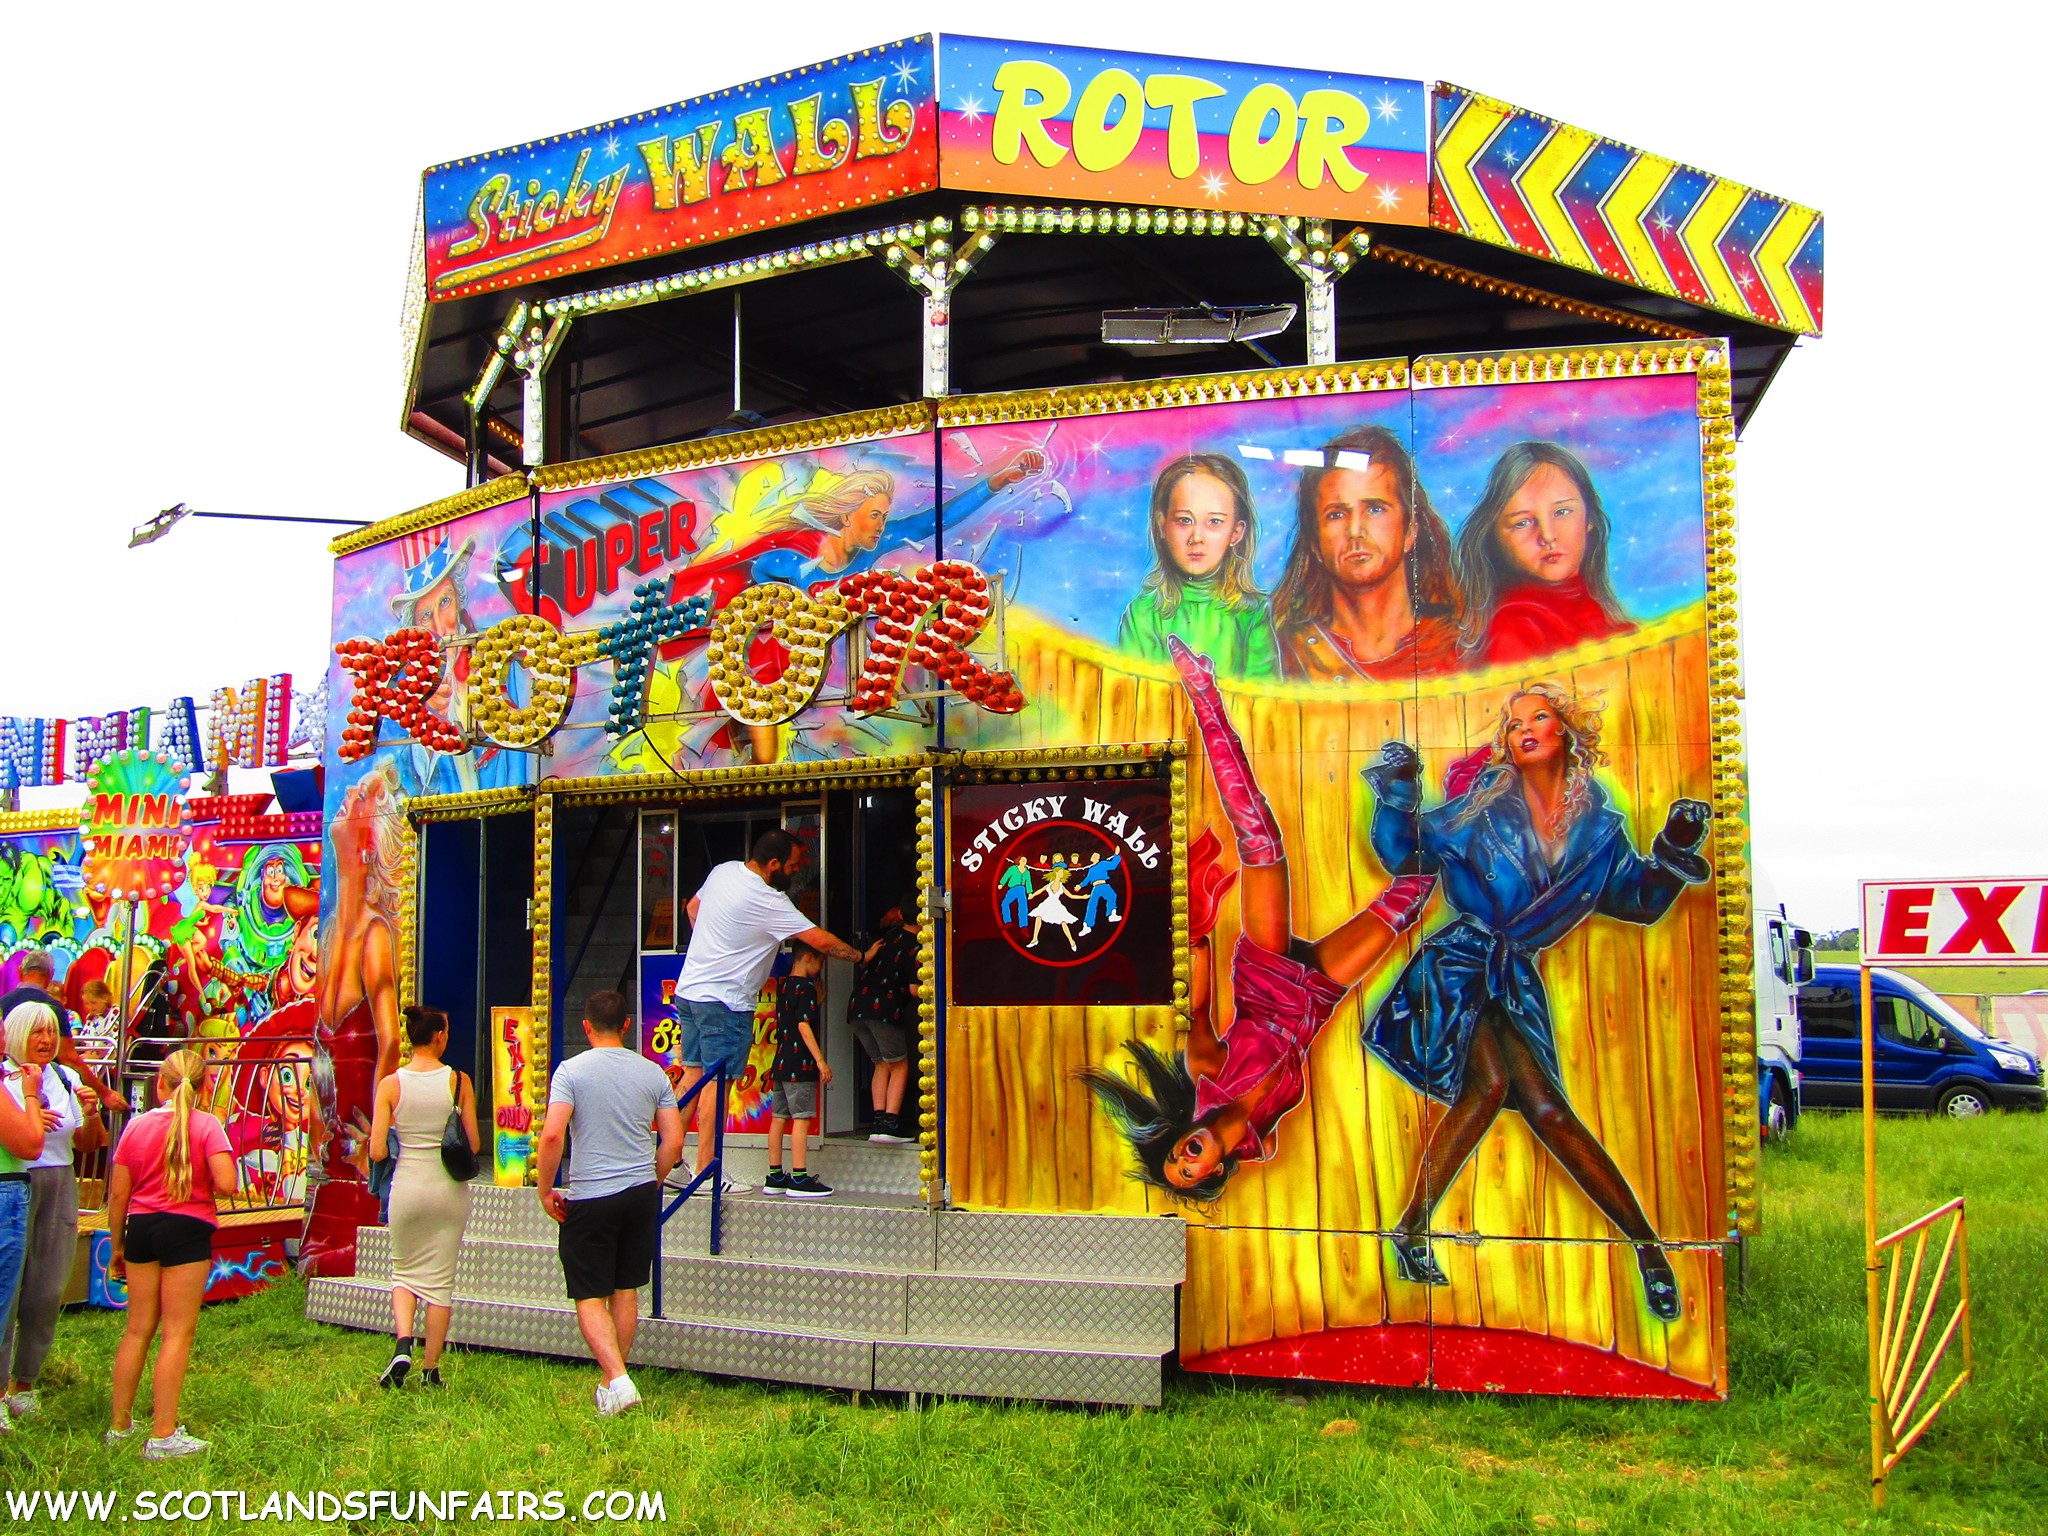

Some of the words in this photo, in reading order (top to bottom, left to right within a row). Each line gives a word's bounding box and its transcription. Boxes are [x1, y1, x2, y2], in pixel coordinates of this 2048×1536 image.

[991, 60, 1371, 193] ROTOR
[445, 147, 630, 262] Sticky
[637, 76, 915, 212] WALL
[497, 482, 701, 627] SUPER
[89, 834, 183, 861] MIAMI
[92, 792, 182, 829] MINI
[960, 795, 1067, 873] STICKY
[1082, 797, 1161, 869] WALL
[504, 1017, 525, 1106] EXIT
[498, 1107, 531, 1132] ONLY
